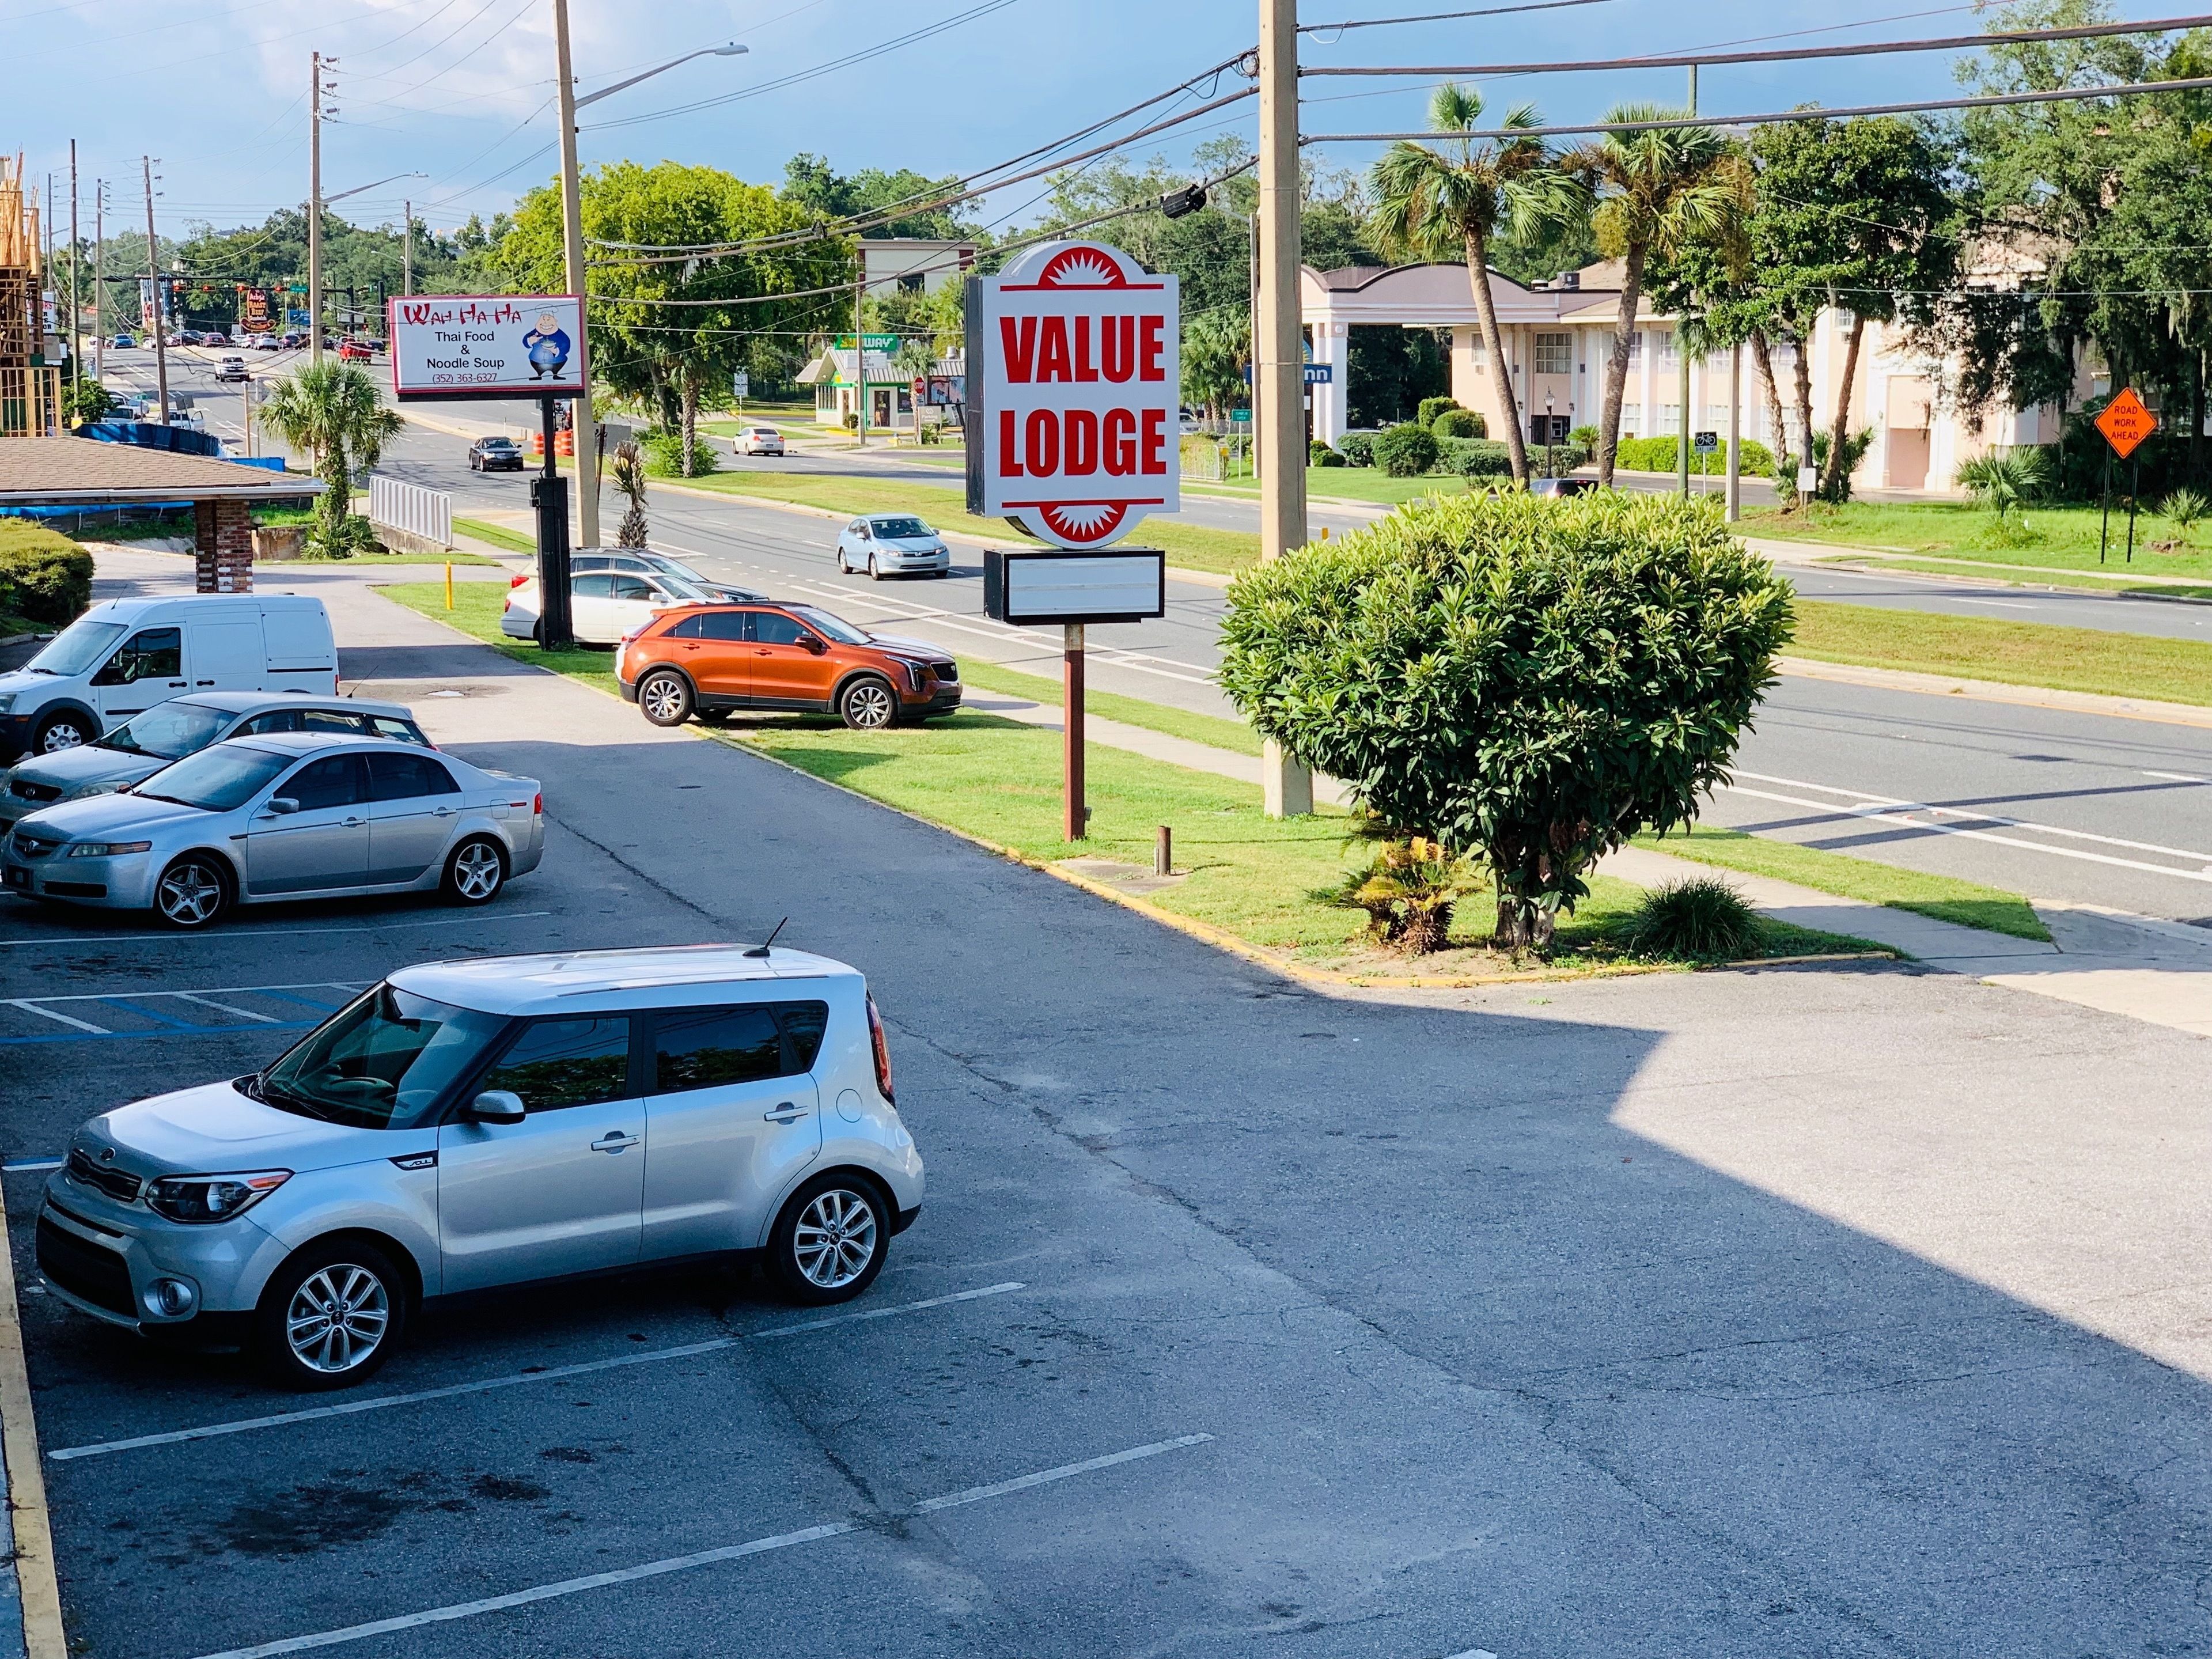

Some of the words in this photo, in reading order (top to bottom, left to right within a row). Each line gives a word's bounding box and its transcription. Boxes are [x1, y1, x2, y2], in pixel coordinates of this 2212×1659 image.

[460, 303, 487, 325] HA
[495, 303, 522, 324] HA
[434, 331, 461, 342] Thai
[465, 331, 494, 342] Food
[839, 338, 894, 349] SUWAY
[460, 344, 470, 355] &
[999, 315, 1165, 384] VALUE
[427, 358, 469, 369] Noodle
[474, 357, 505, 370] Soup
[432, 374, 453, 384] (352)
[457, 373, 497, 382] 363-6327
[1304, 369, 1328, 380] nn
[2114, 406, 2138, 415] ROAD
[2113, 418, 2137, 427] WORK
[2111, 431, 2139, 440] AHEAD
[999, 407, 1166, 478] LODGE
